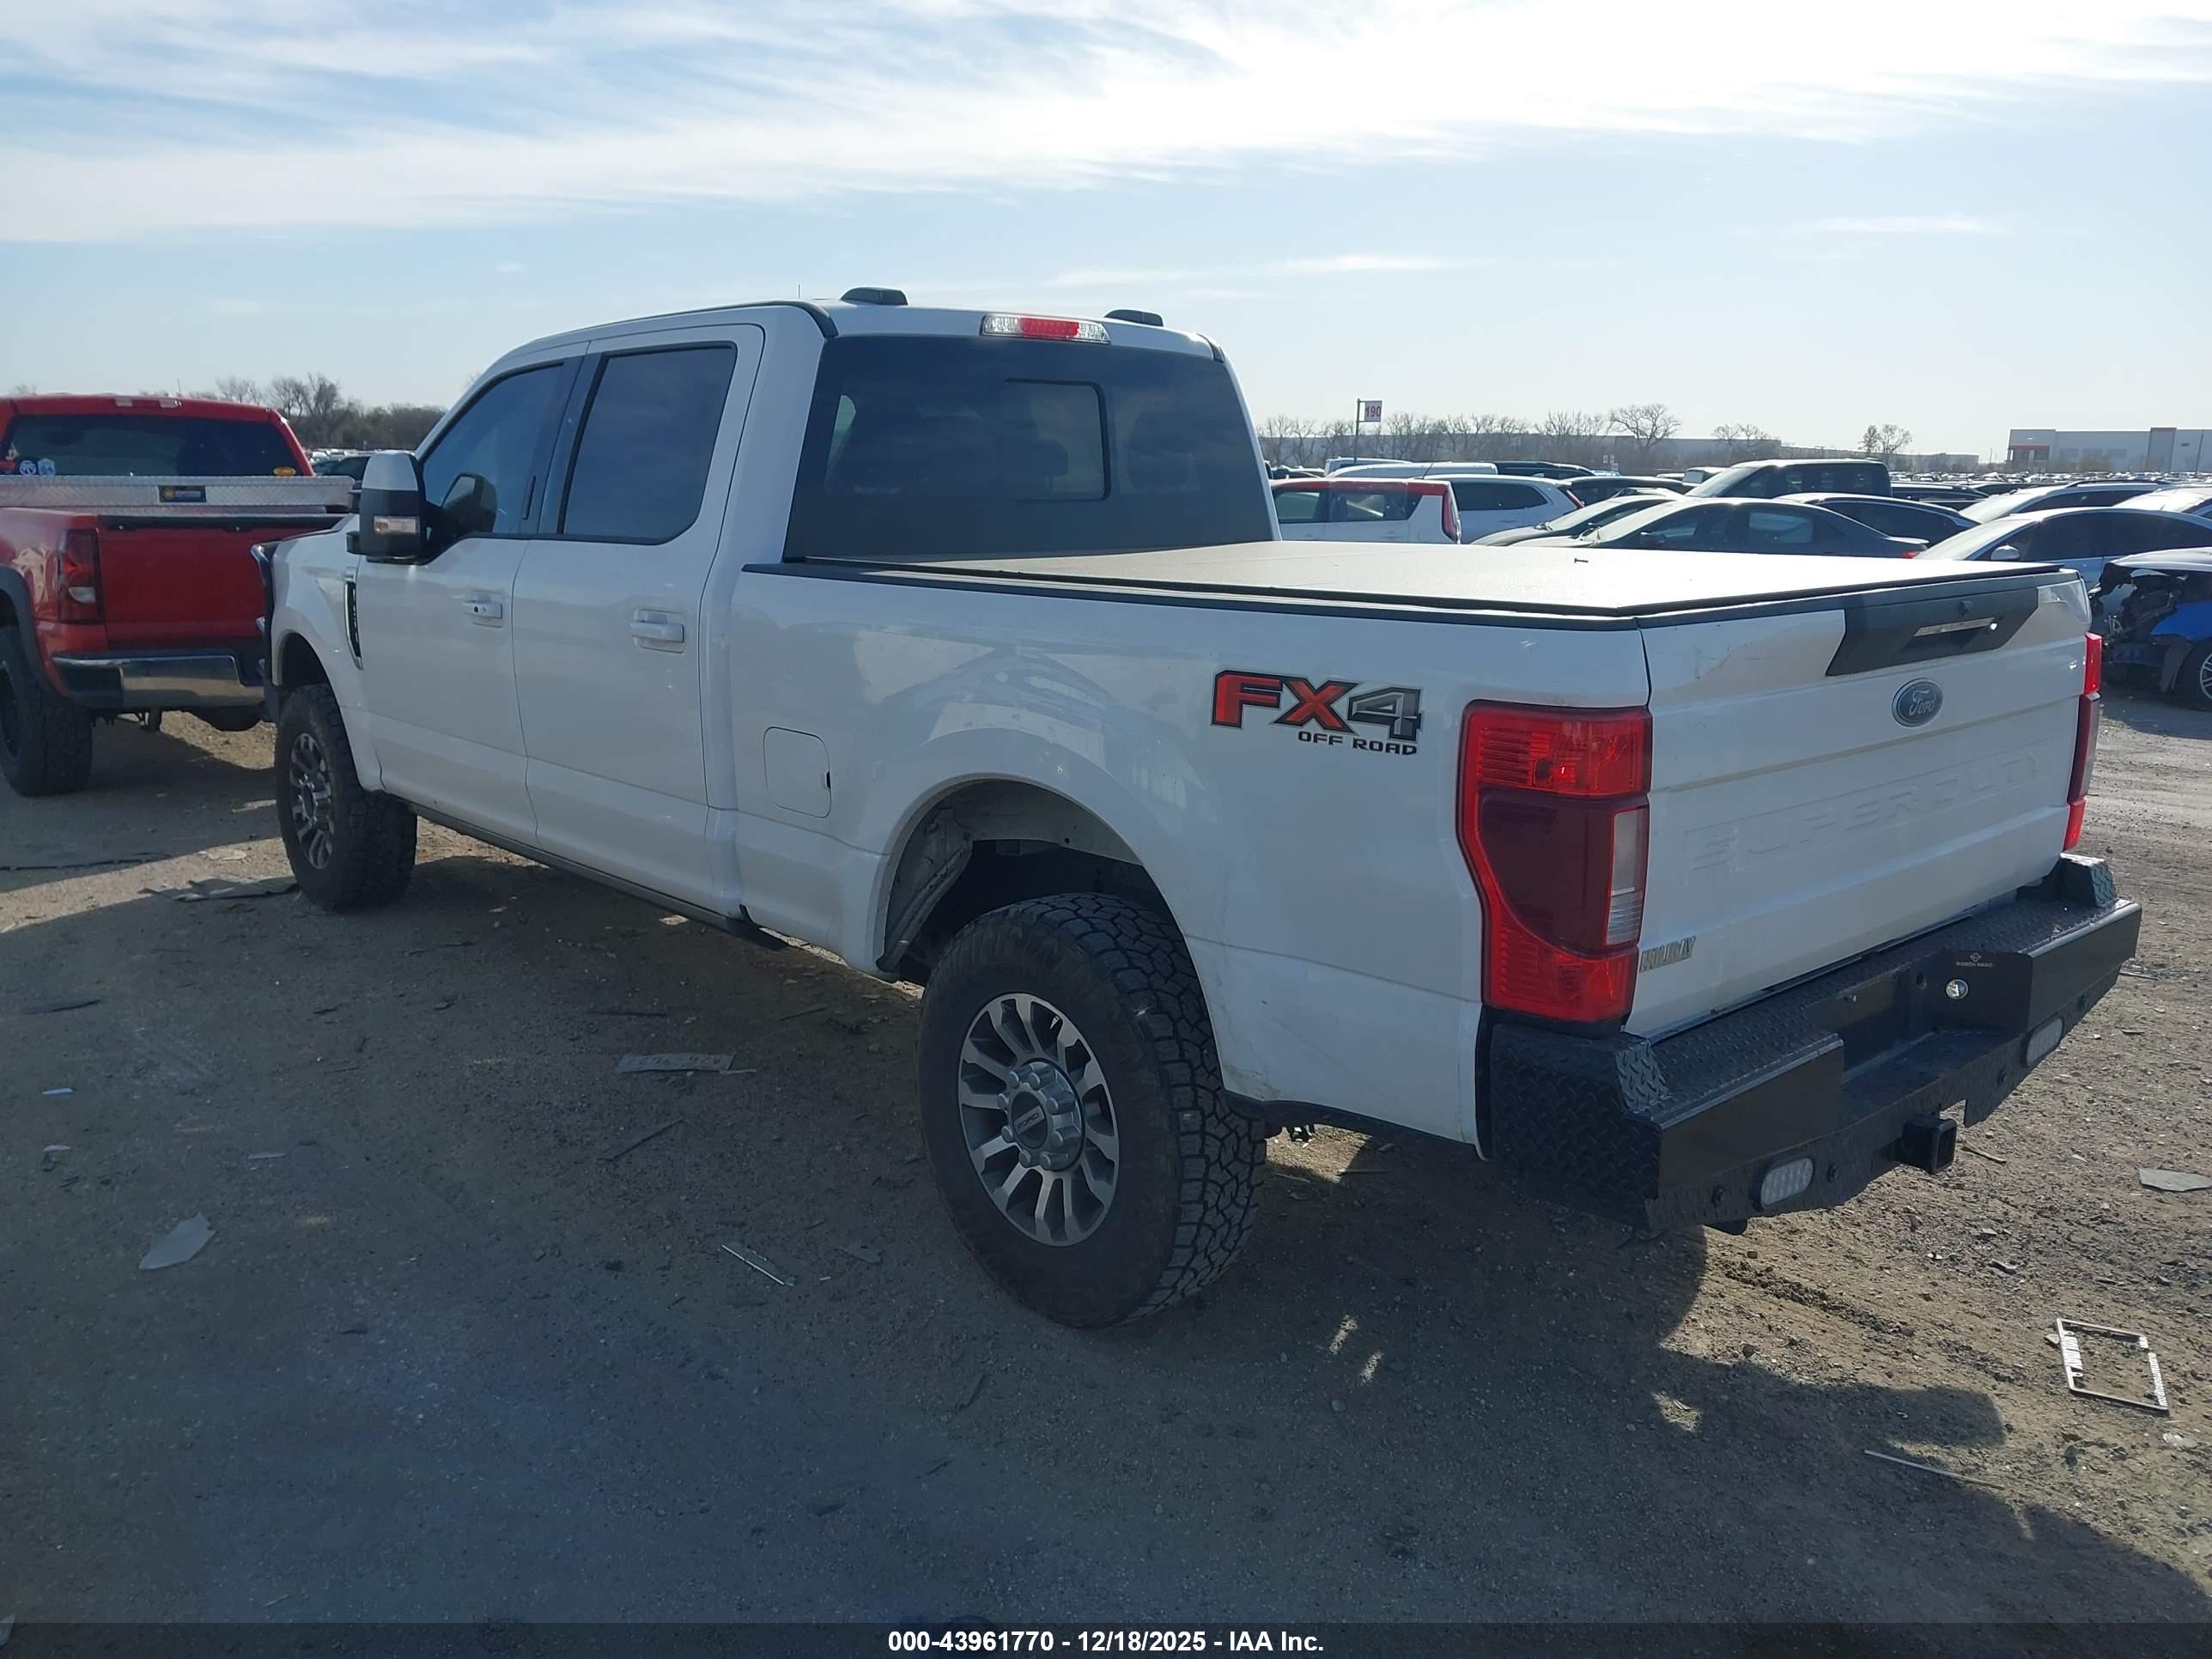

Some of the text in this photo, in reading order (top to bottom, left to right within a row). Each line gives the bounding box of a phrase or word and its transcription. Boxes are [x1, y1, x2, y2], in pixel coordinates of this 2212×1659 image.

[1365, 405, 1382, 417] 190
[1211, 670, 1422, 741] FX4
[1297, 731, 1418, 756] OFF ROAD
[1017, 1112, 1040, 1129] FORD
